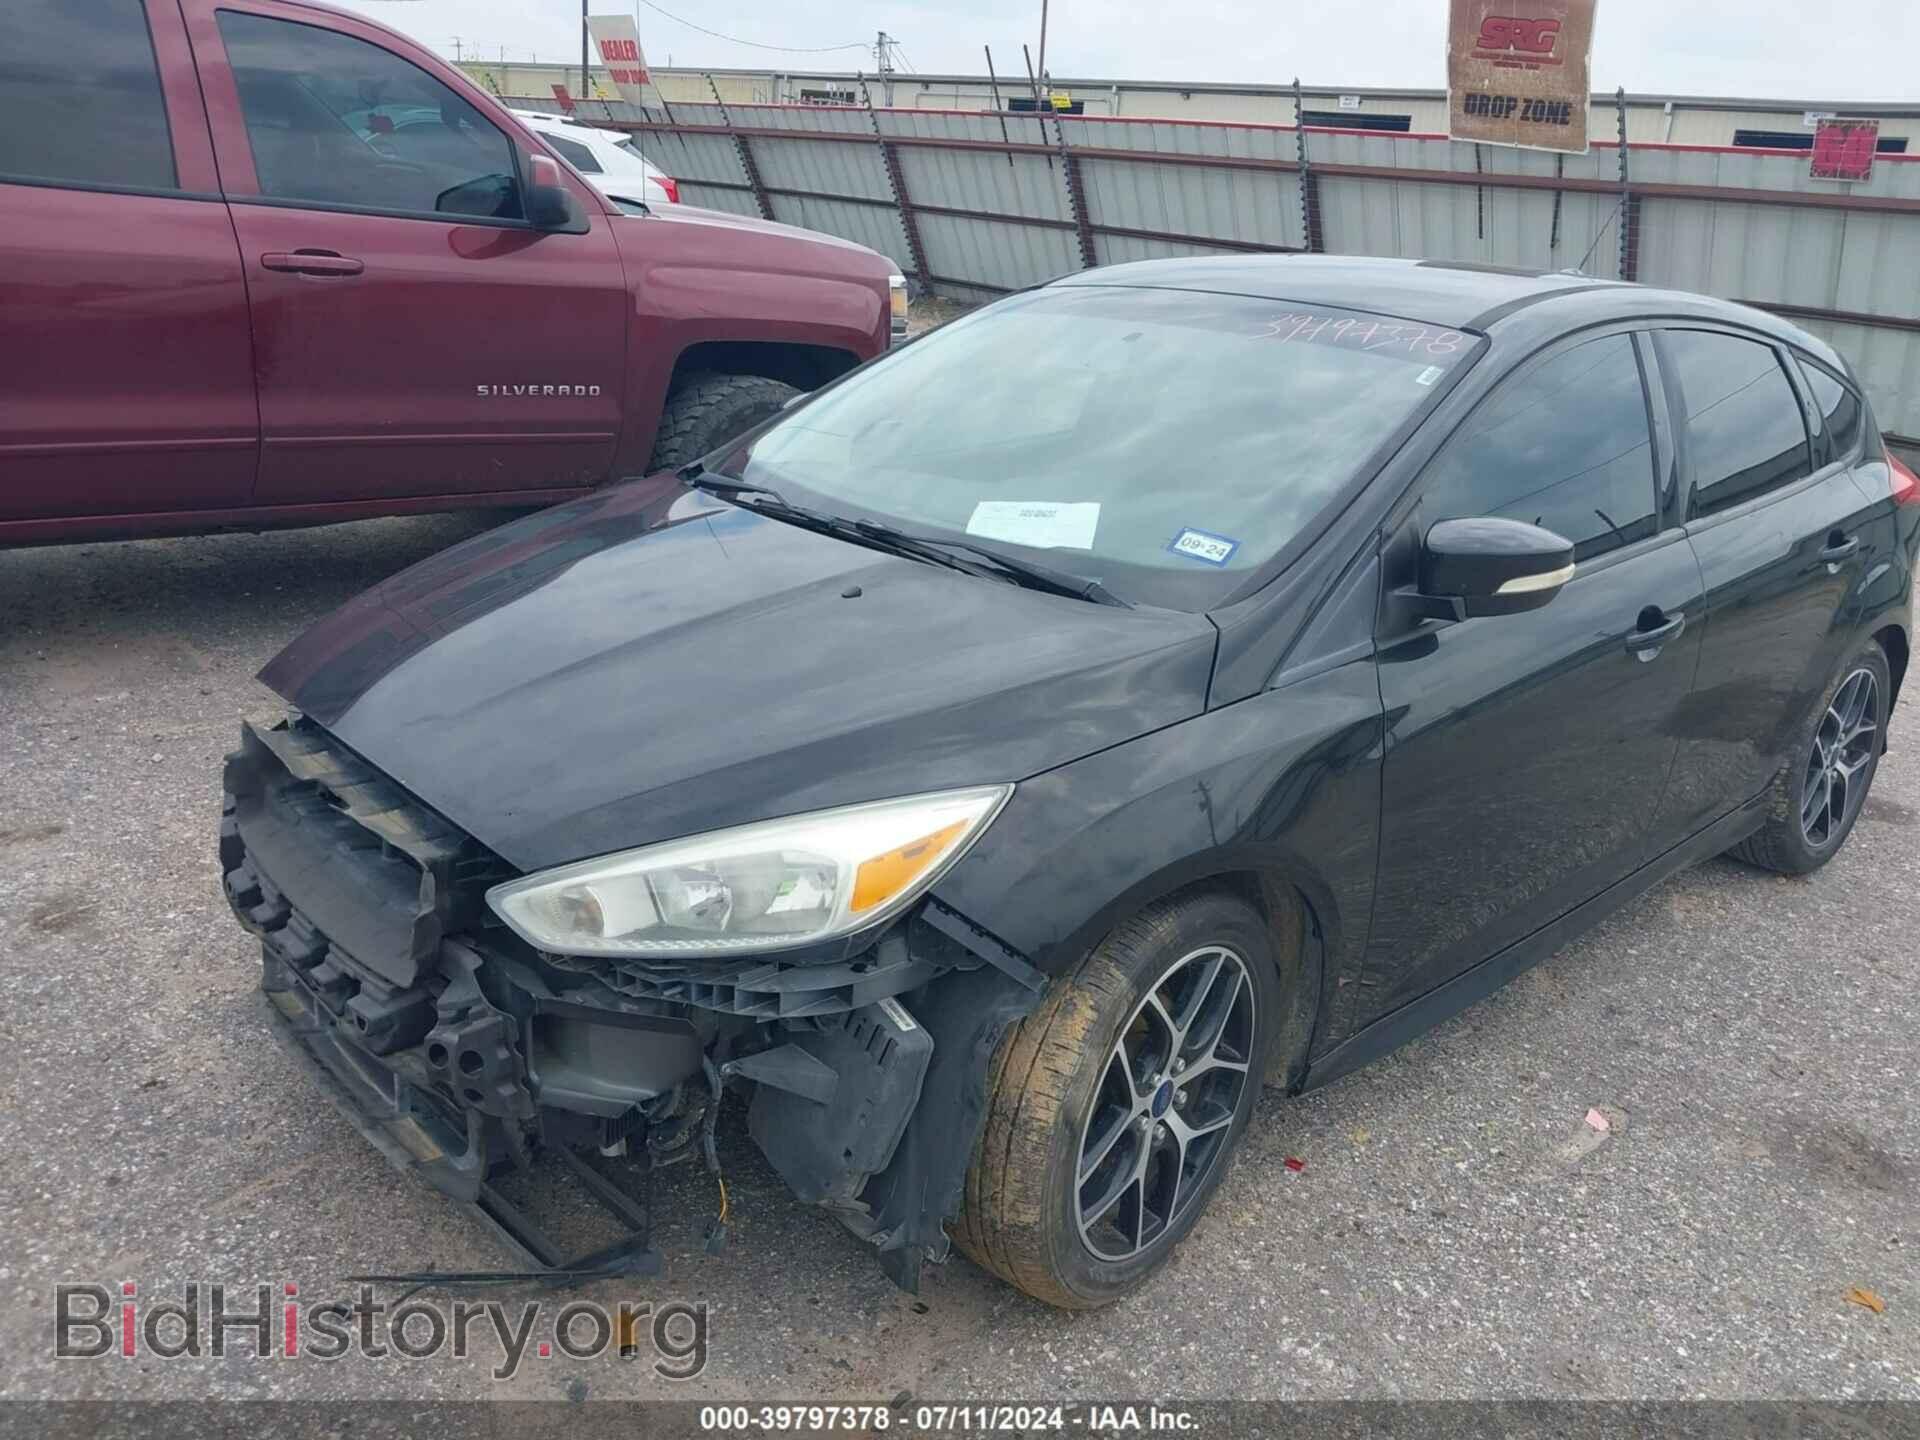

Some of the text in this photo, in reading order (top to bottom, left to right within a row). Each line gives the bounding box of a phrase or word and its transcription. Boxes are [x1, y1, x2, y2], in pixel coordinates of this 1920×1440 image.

[1476, 16, 1561, 53] SRG
[600, 39, 638, 61] DEALER
[1464, 93, 1573, 126] DROP ZONE
[476, 384, 601, 397] SILVERADO
